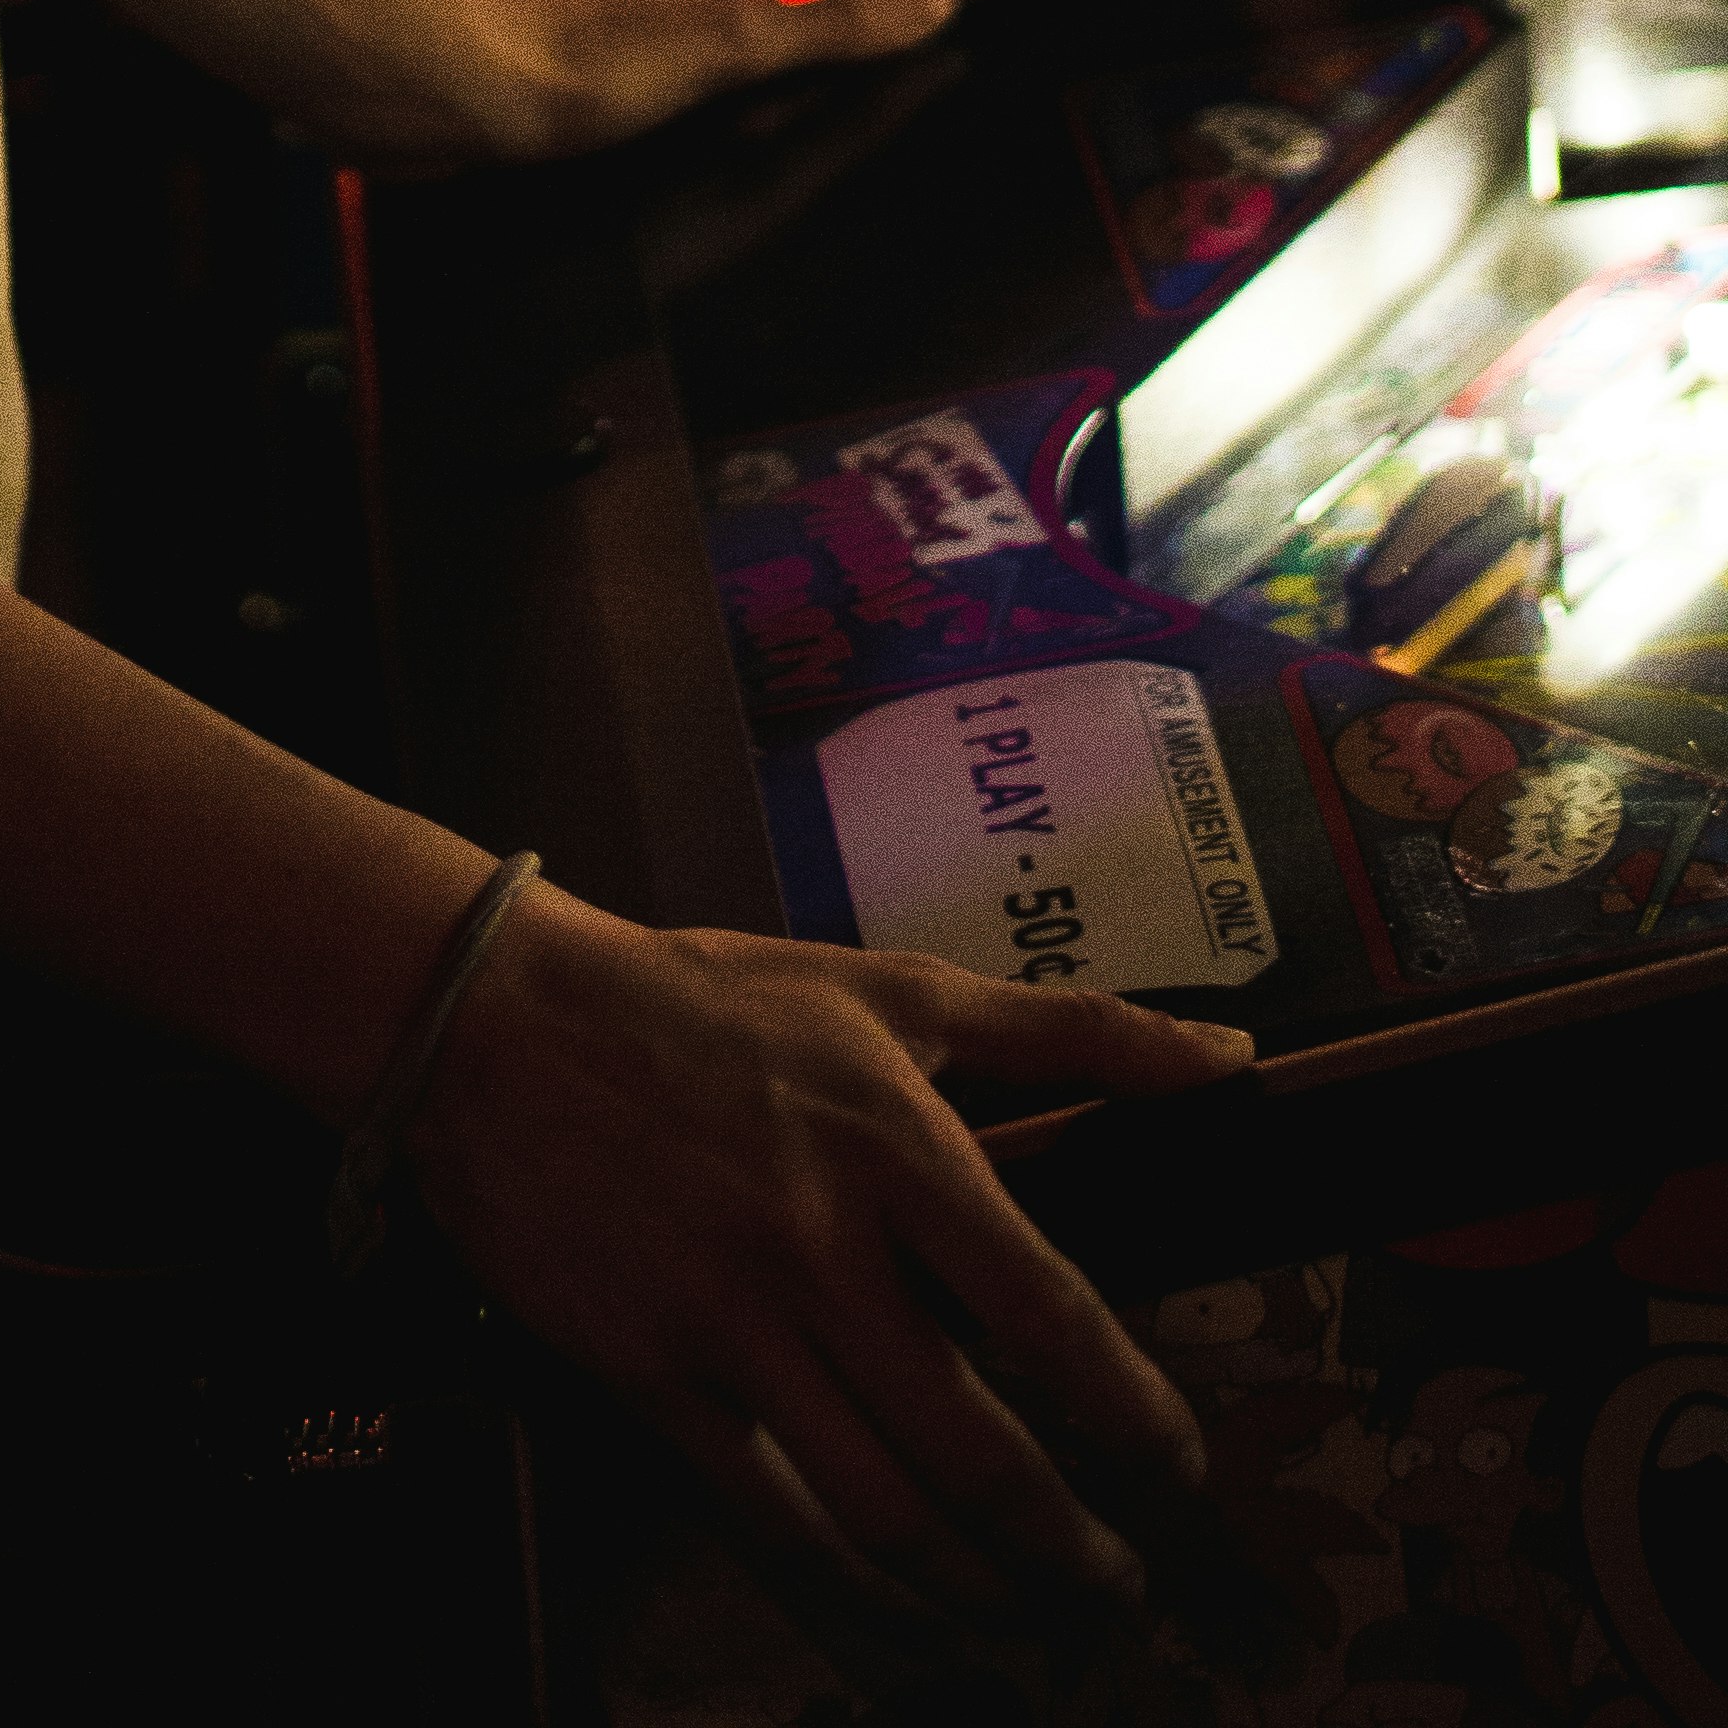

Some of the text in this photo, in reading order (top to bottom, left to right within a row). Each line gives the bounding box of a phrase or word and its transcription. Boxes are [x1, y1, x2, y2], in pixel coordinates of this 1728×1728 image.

[955, 694, 1089, 983] 1 PLAY - 50¢
[1161, 717, 1239, 864] AMUSEMENT
[1205, 878, 1267, 956] ONLY
